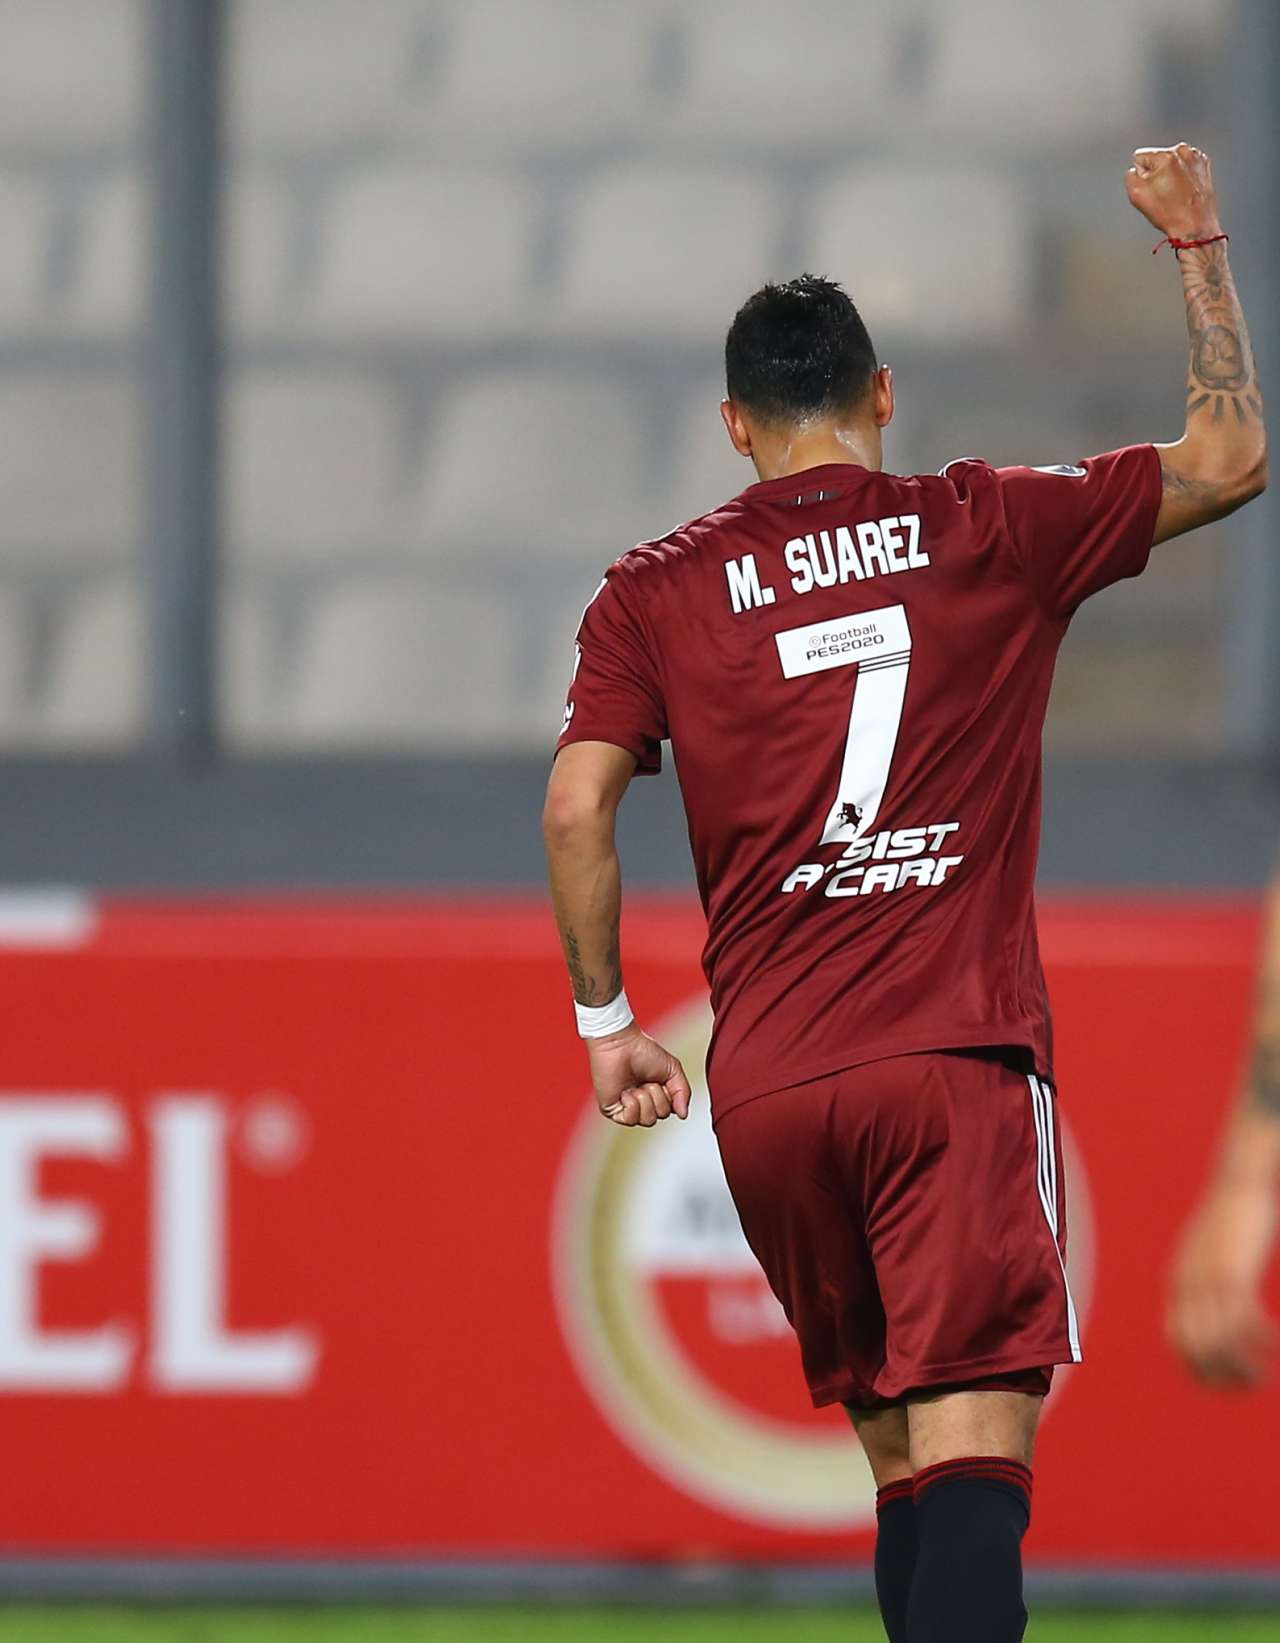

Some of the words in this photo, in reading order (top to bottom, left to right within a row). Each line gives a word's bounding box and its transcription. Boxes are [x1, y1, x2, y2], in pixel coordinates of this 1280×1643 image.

[725, 554, 776, 614] M.
[784, 514, 931, 594] SUAREZ
[806, 634, 885, 661] PES2020
[774, 603, 912, 846] 7
